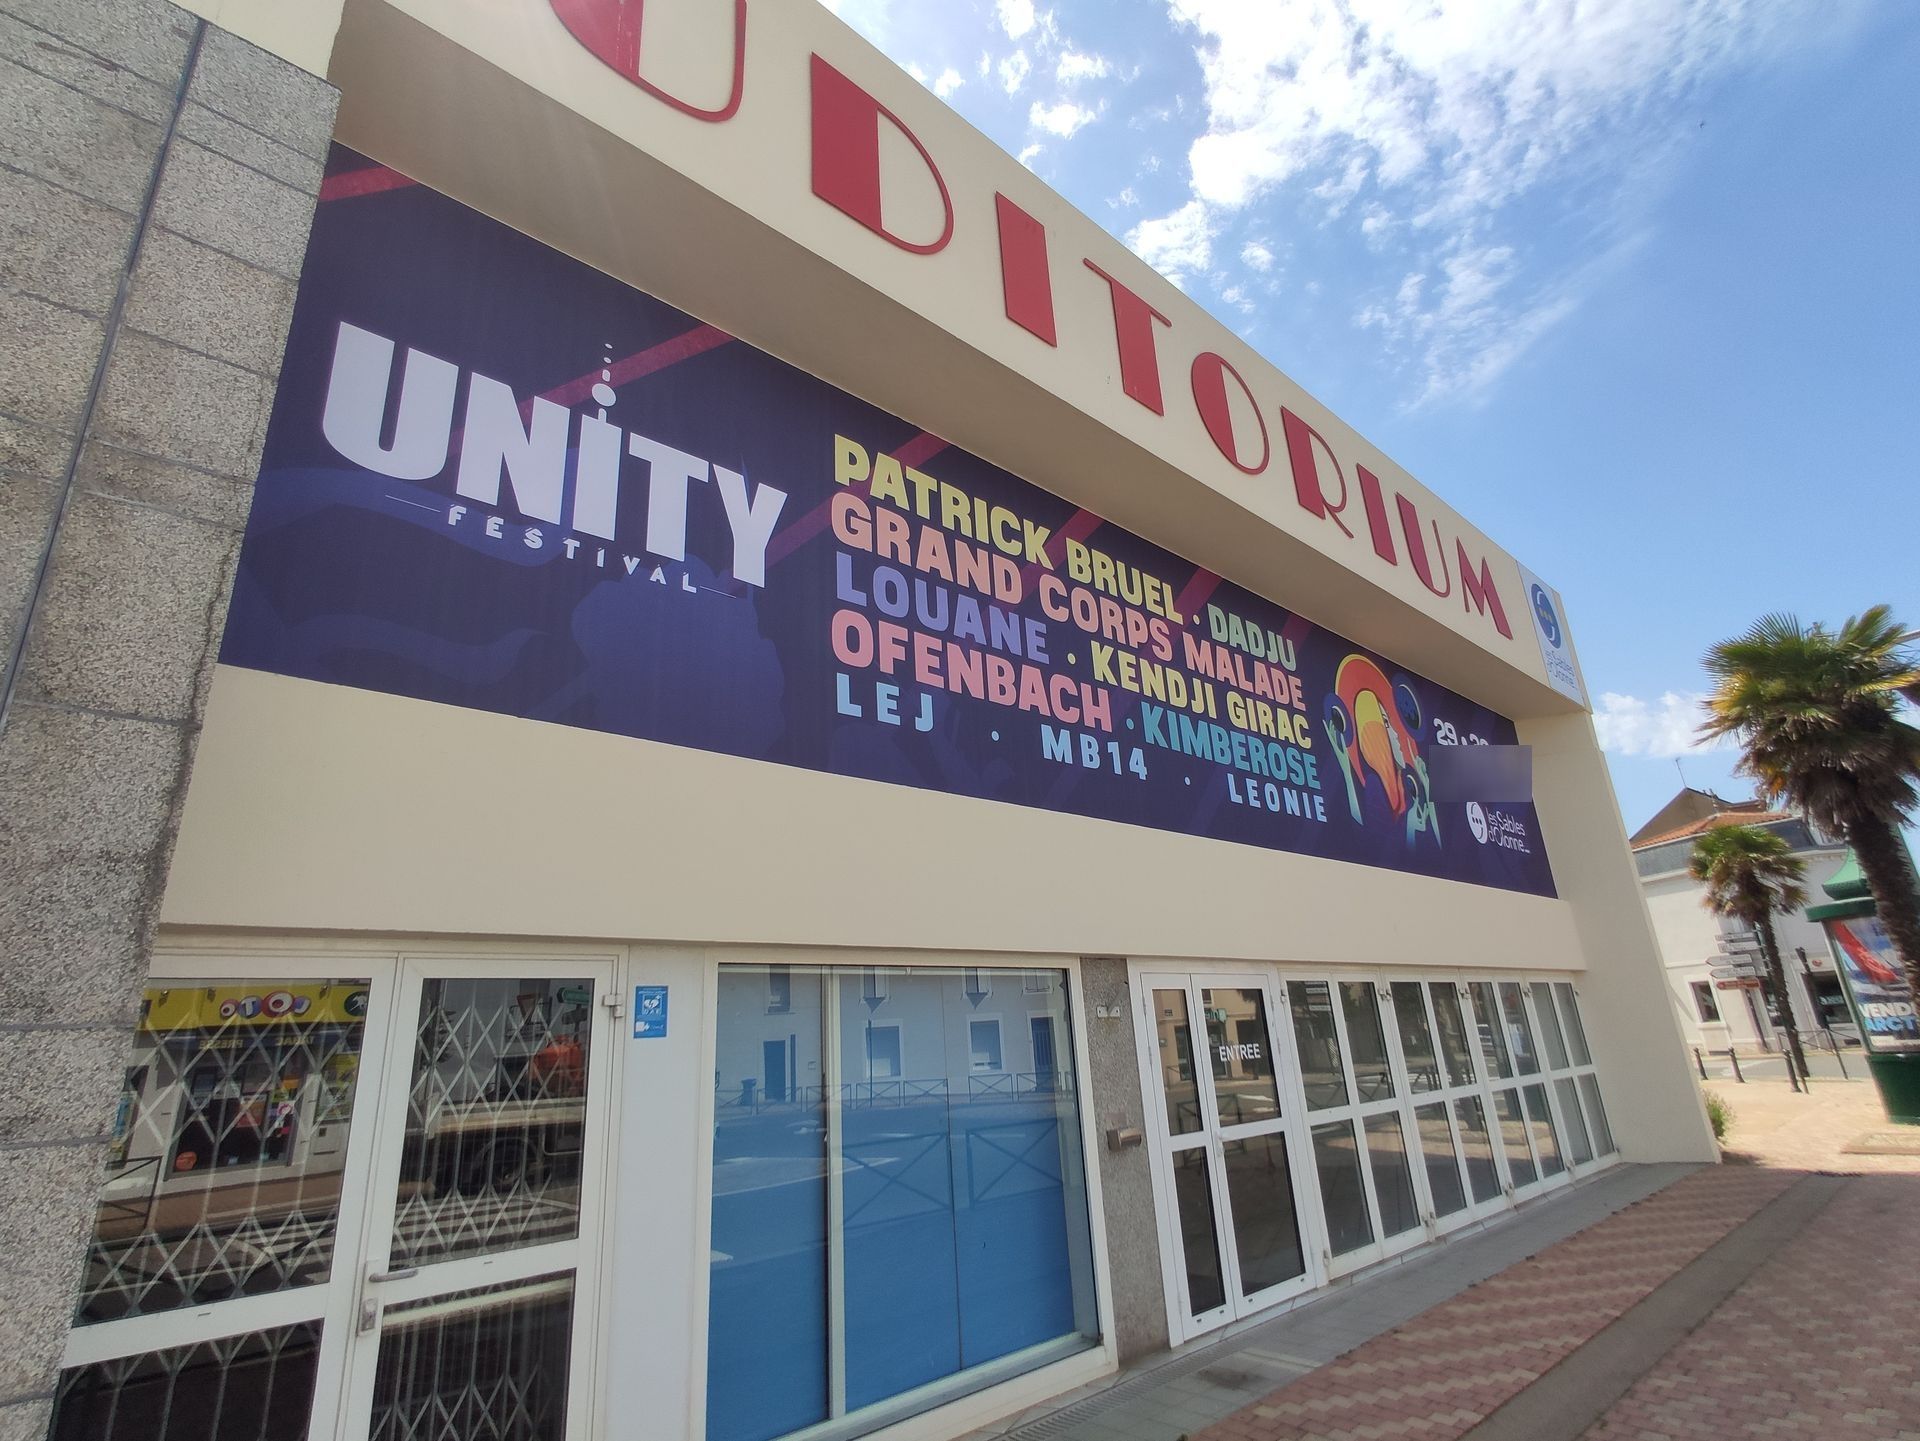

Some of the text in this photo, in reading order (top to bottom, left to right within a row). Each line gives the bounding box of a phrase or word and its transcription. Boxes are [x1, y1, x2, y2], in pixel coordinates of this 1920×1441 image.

[448, 503, 698, 593] FESTIVAL
[831, 492, 1306, 711] GRAND CORPS MALADE
[834, 433, 1296, 672] PATRICK BRUEL DADJU
[831, 608, 1321, 789] OFENBACH KIMBEROSE
[836, 551, 1311, 749] LOUANE KENDJI GIRAC
[1433, 717, 1458, 745] 29
[836, 672, 934, 732] LEJ
[1227, 773, 1328, 823] LEONIE
[1219, 1043, 1261, 1061] ENTREE
